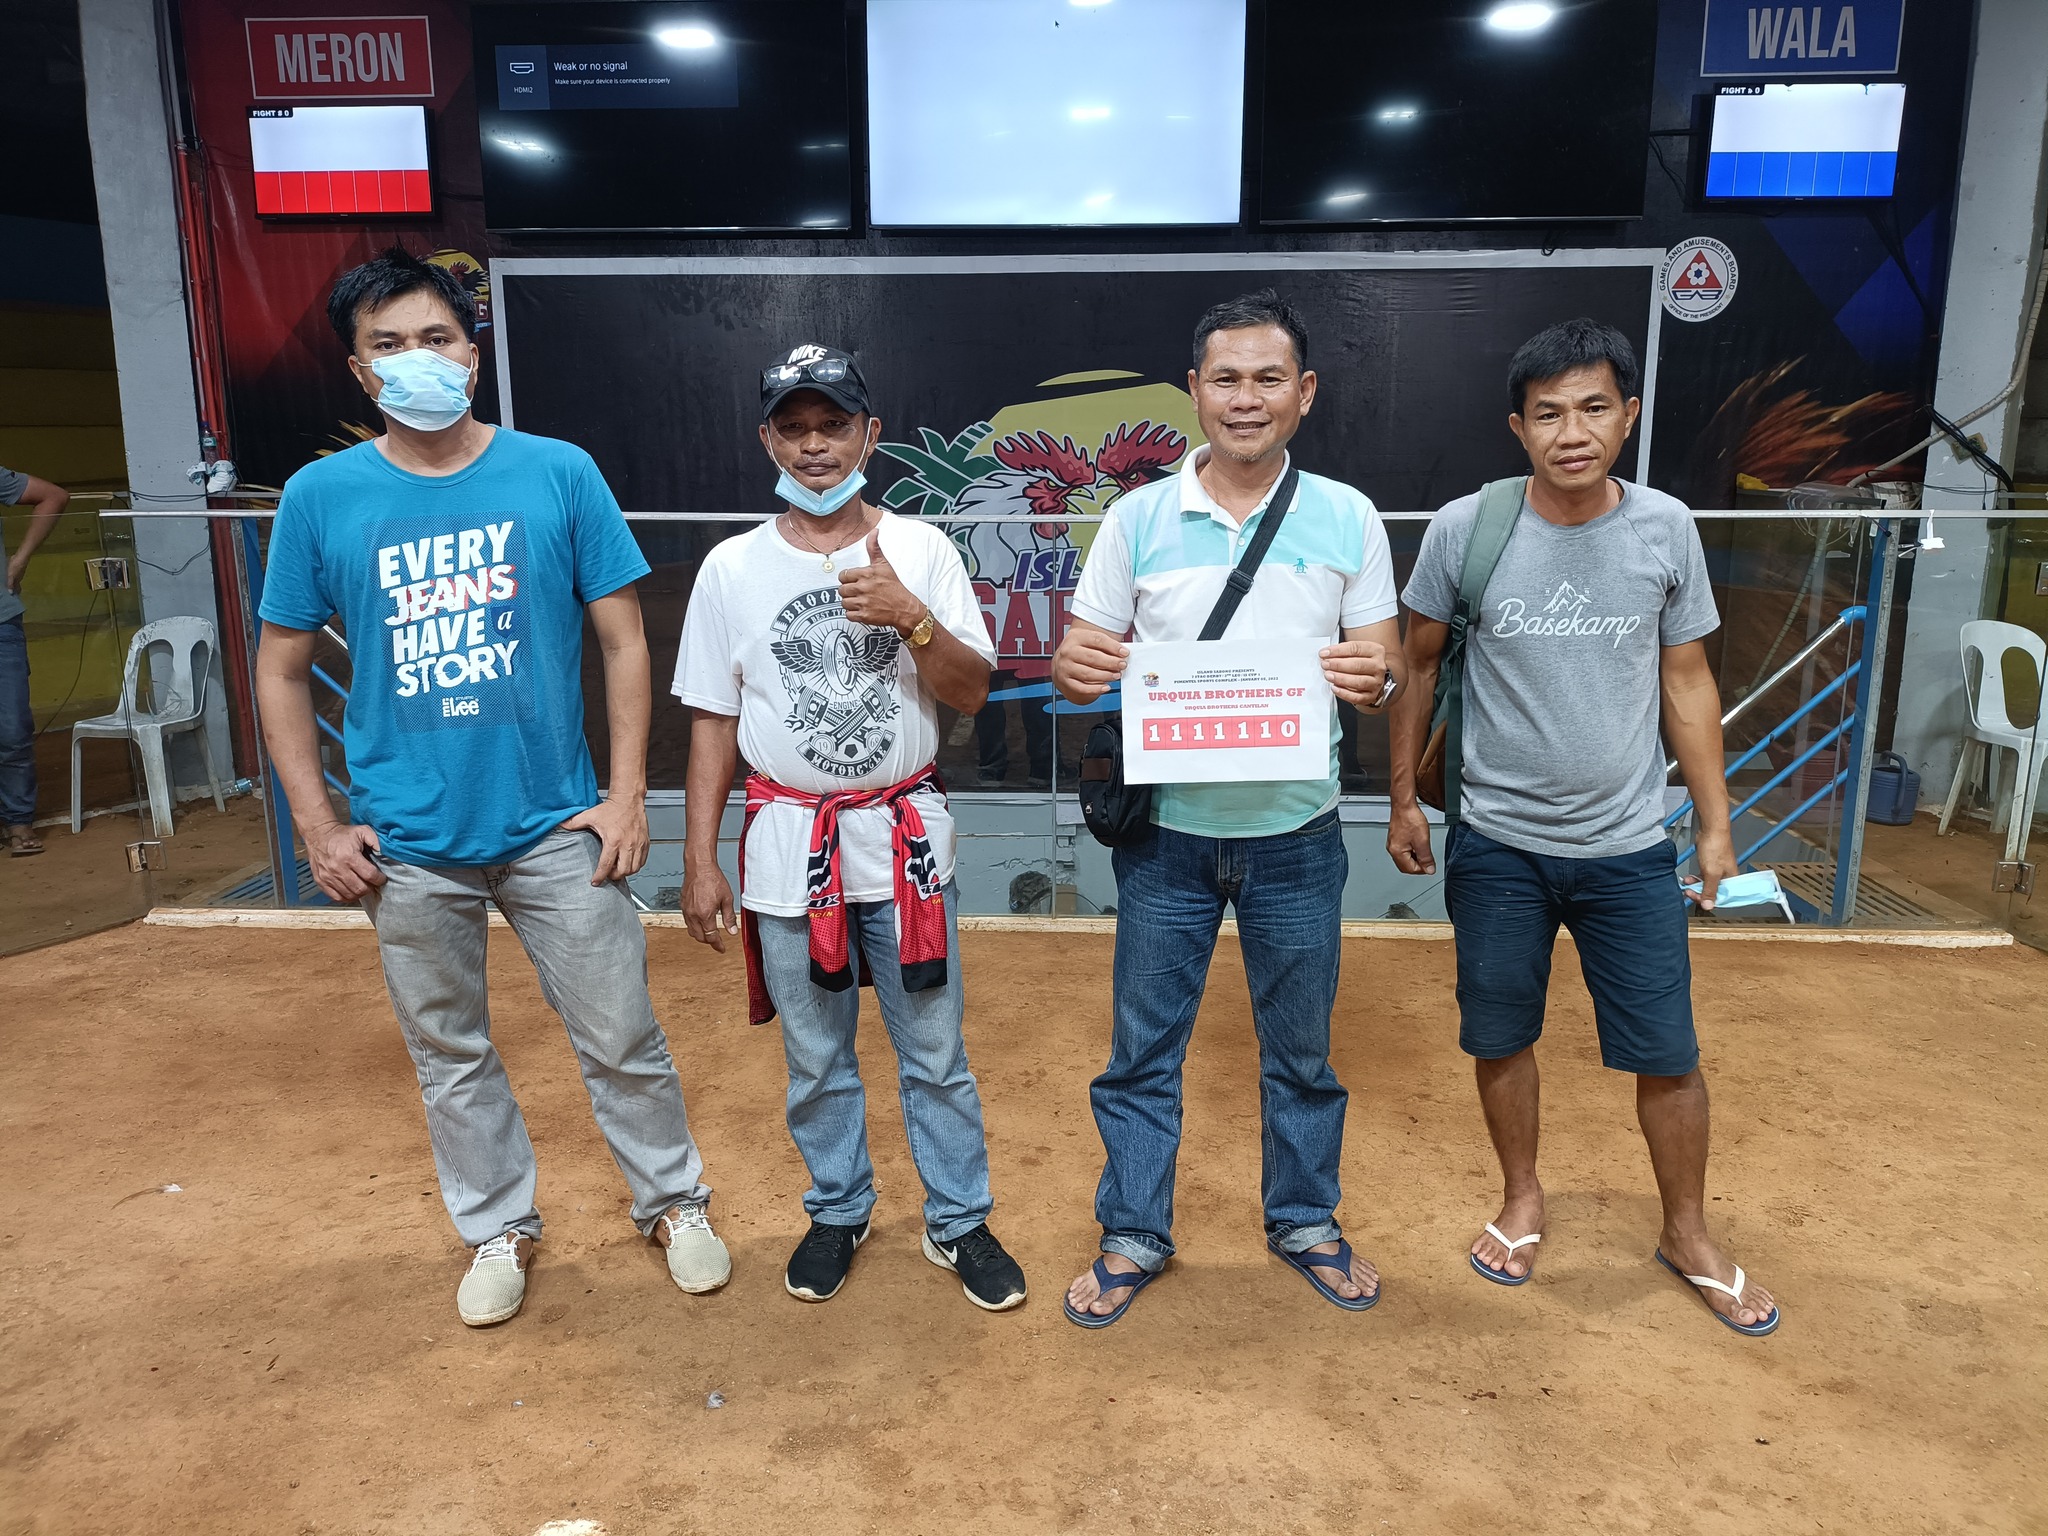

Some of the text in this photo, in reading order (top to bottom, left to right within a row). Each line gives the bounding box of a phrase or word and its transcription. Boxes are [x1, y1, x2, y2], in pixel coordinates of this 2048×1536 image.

[1747, 5, 1857, 59] WALA
[274, 32, 406, 84] MERON
[553, 61, 628, 72] Weak or no signal
[513, 86, 533, 94] HDMI2
[648, 77, 671, 86] properly
[1659, 238, 1737, 291] GAMES AND AMUSEMENTS BOARD
[1668, 303, 1683, 316] OFFICE
[1699, 302, 1724, 318] PRESIDENT
[787, 344, 828, 365] NIKE
[378, 520, 515, 590] EVERY
[1011, 547, 1083, 593] ISL
[384, 564, 519, 626] JEANS
[781, 589, 843, 623] BROOK
[811, 608, 847, 623] BEST TYR
[1492, 598, 1641, 649] Basekamp
[392, 607, 515, 665] HAVE a
[396, 639, 520, 698] STORY
[450, 697, 480, 716] Lee
[833, 700, 859, 710] ENGINE
[1148, 687, 1306, 703] URQUIA BROTHERS GF
[819, 741, 828, 751] 19
